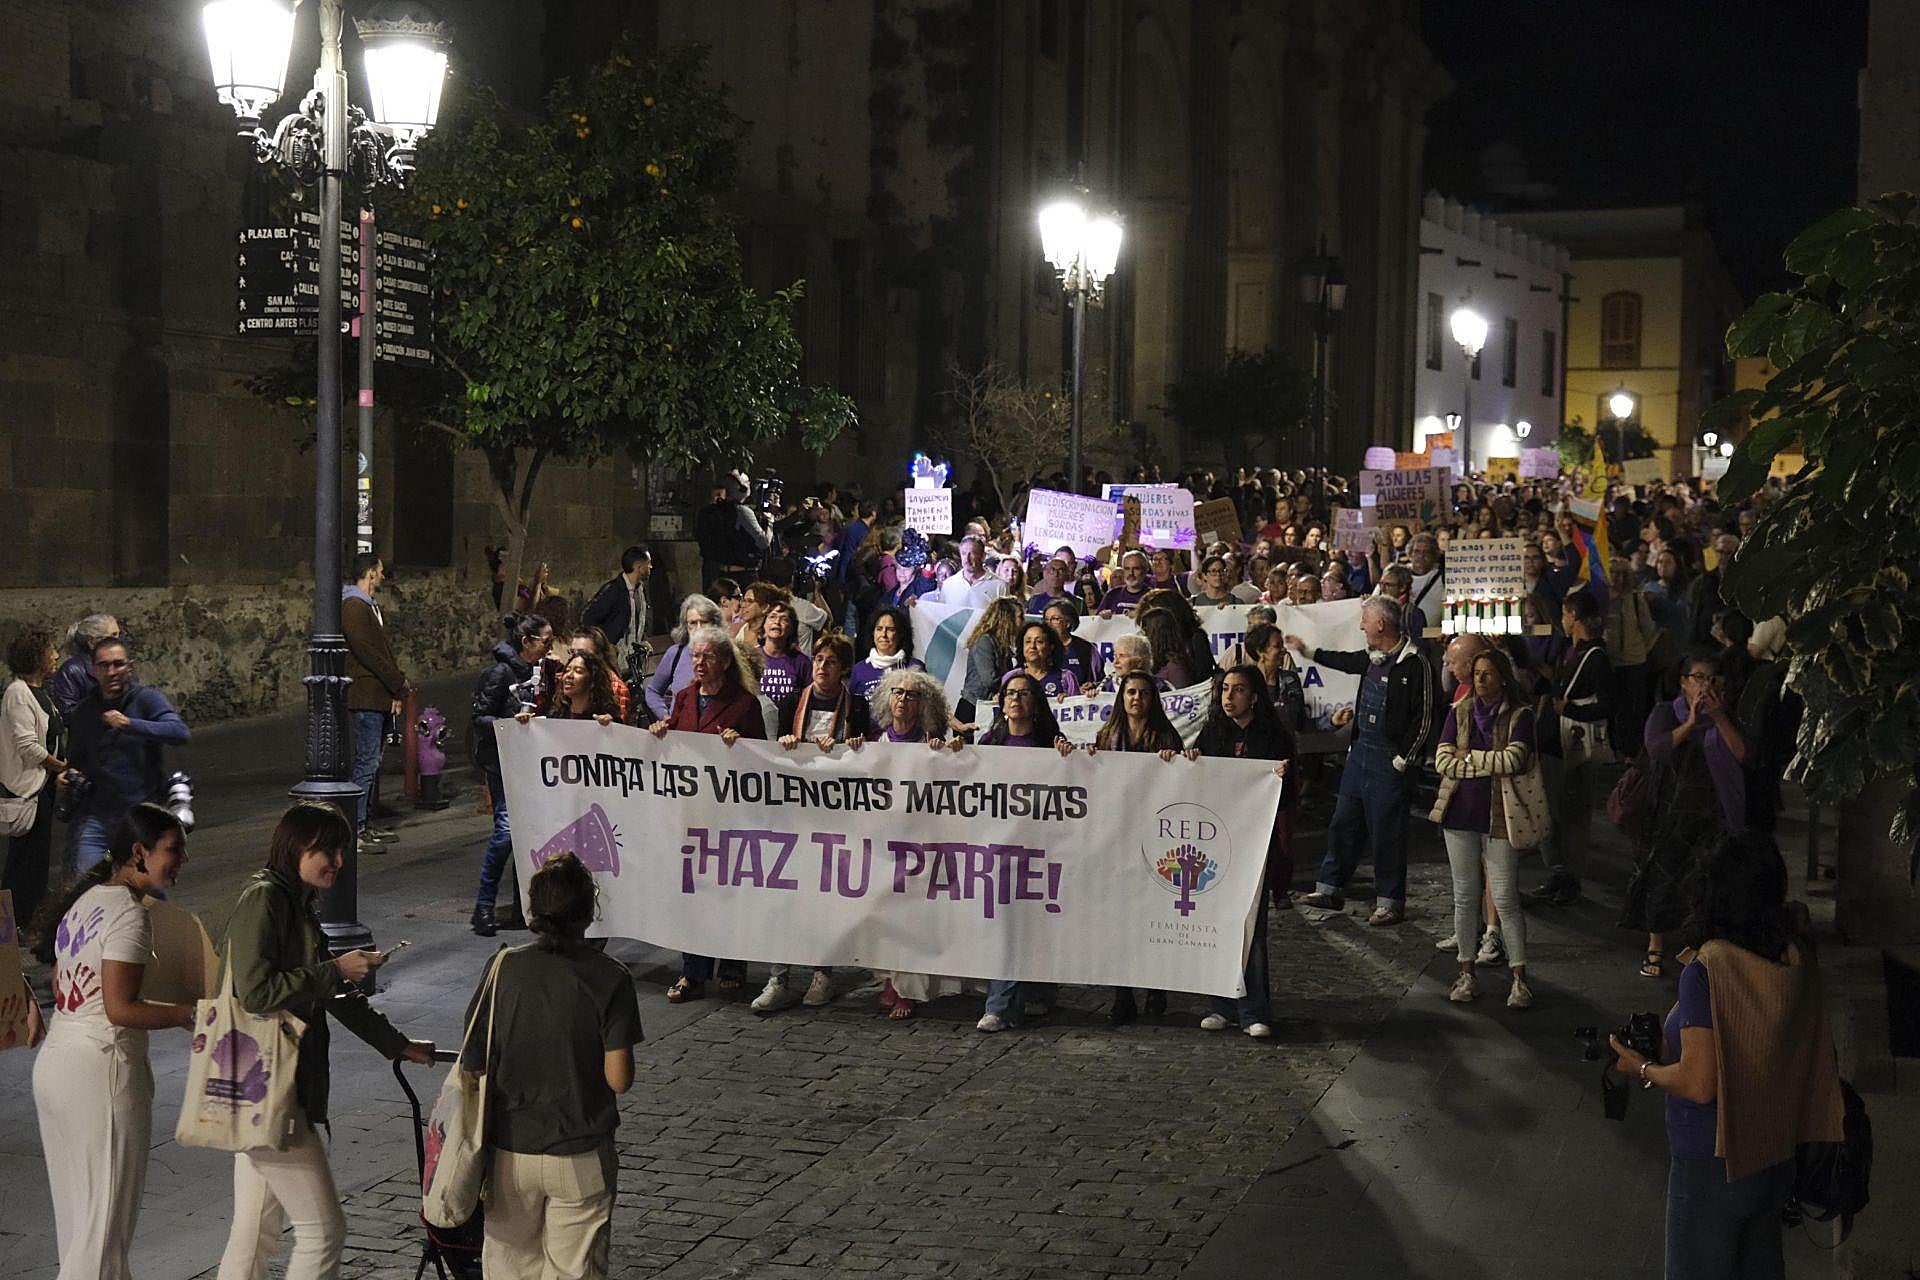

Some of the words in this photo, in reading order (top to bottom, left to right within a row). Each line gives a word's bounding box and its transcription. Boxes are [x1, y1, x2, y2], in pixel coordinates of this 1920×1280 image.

[247, 229, 273, 239] PLAZA
[267, 296, 282, 306] SAN
[246, 318, 273, 329] CENTRO
[274, 318, 298, 328] ARTES
[1374, 472, 1402, 487] 25N
[1406, 470, 1432, 486] LAS
[1129, 493, 1174, 505] MUJERES
[1129, 507, 1163, 517] SORDAS
[1048, 519, 1085, 533] SORDAS
[1145, 519, 1179, 529] LIBRES
[540, 753, 645, 798] CONTRA
[651, 760, 699, 799] LAS
[704, 765, 893, 812] VIOLENCIAS
[900, 780, 1088, 822] MACHISTAS
[1158, 818, 1217, 841] RED
[681, 827, 799, 894] ¡HAZ
[811, 832, 872, 898] TU
[887, 841, 1062, 919] PARTE!
[1150, 920, 1218, 934] FEMINISTA
